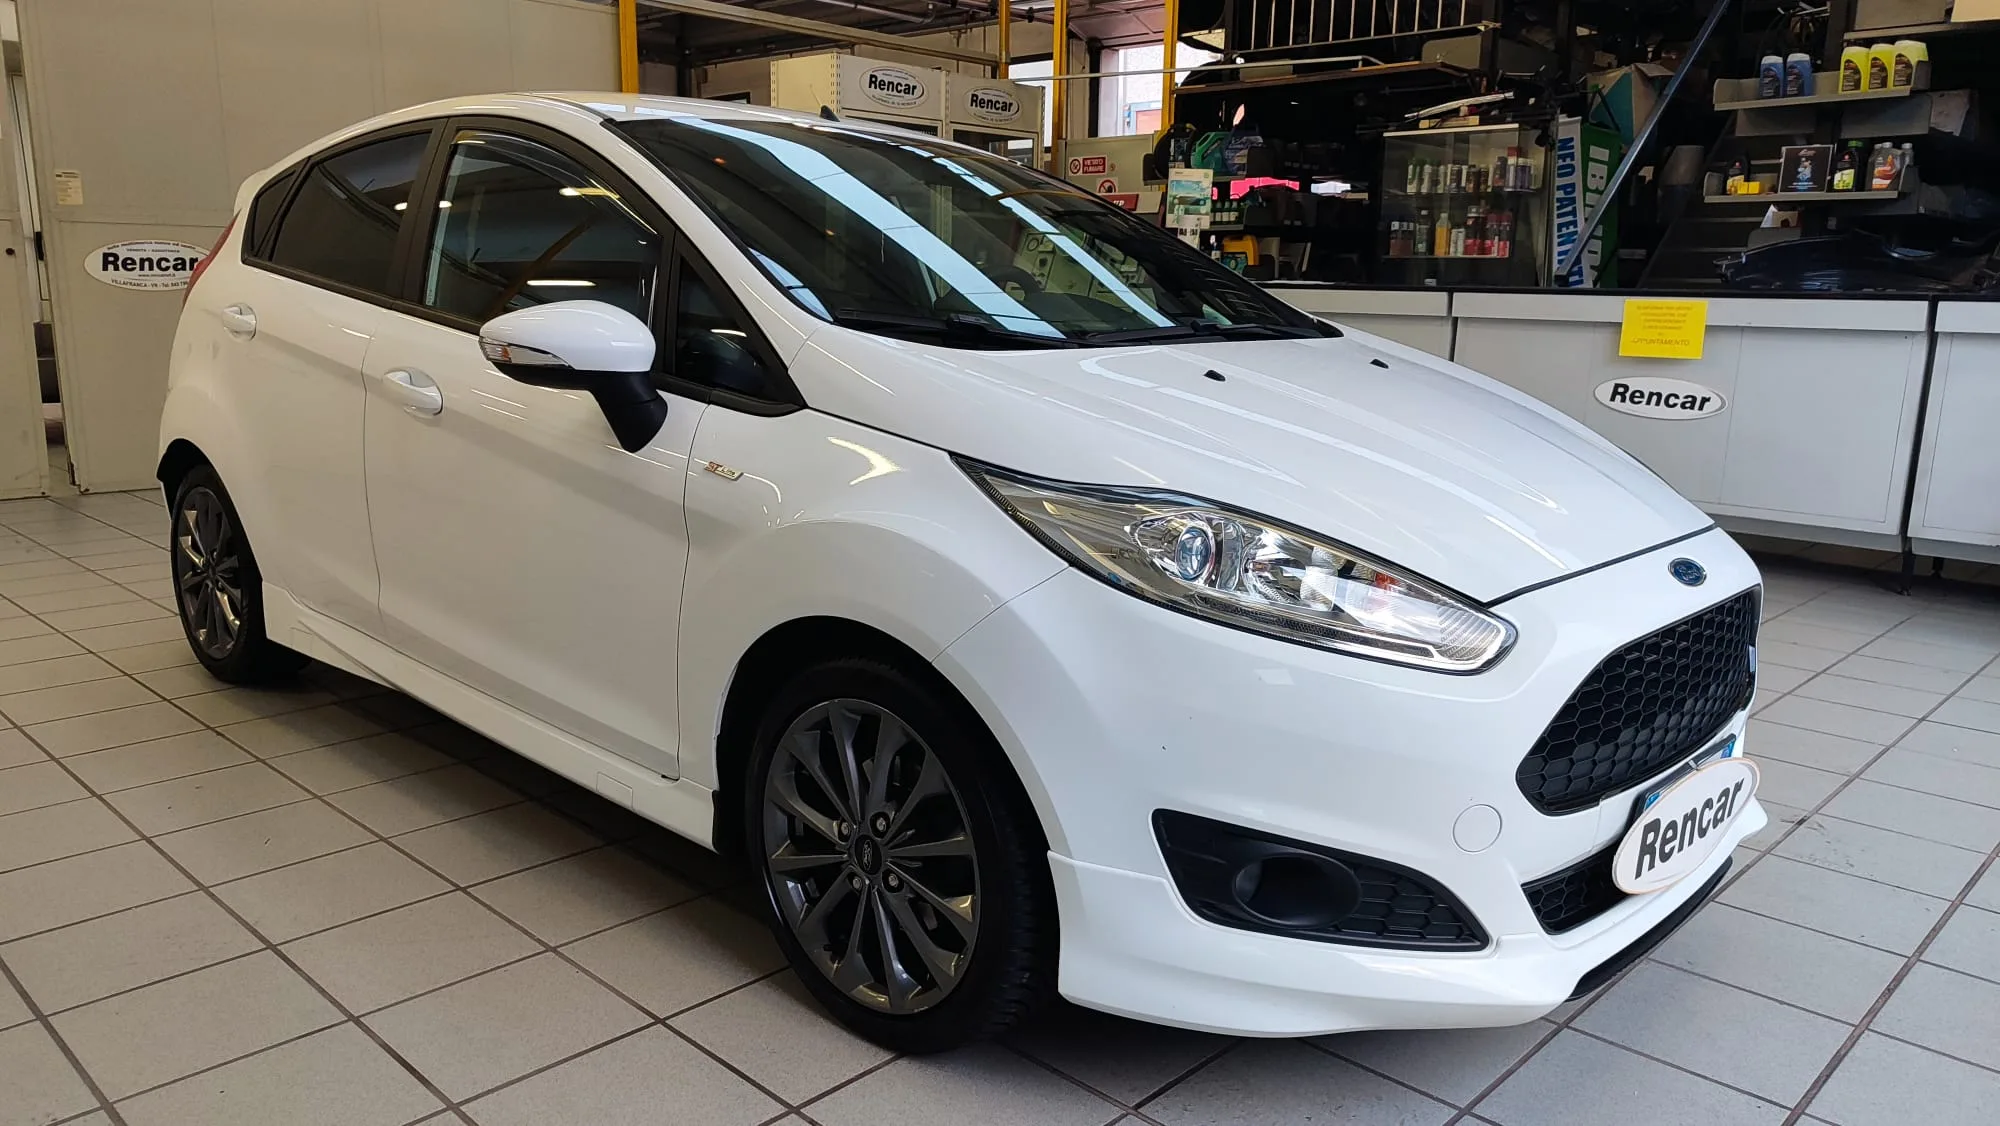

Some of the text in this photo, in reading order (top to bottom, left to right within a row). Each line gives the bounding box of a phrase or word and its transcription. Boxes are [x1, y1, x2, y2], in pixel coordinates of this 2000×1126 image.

[868, 74, 917, 95] Rencar
[970, 93, 1013, 112] Rencar
[1556, 136, 1576, 178] NEO
[102, 252, 198, 272] Rencar
[1609, 383, 1711, 411] Rencar
[1635, 778, 1744, 880] Rencar
